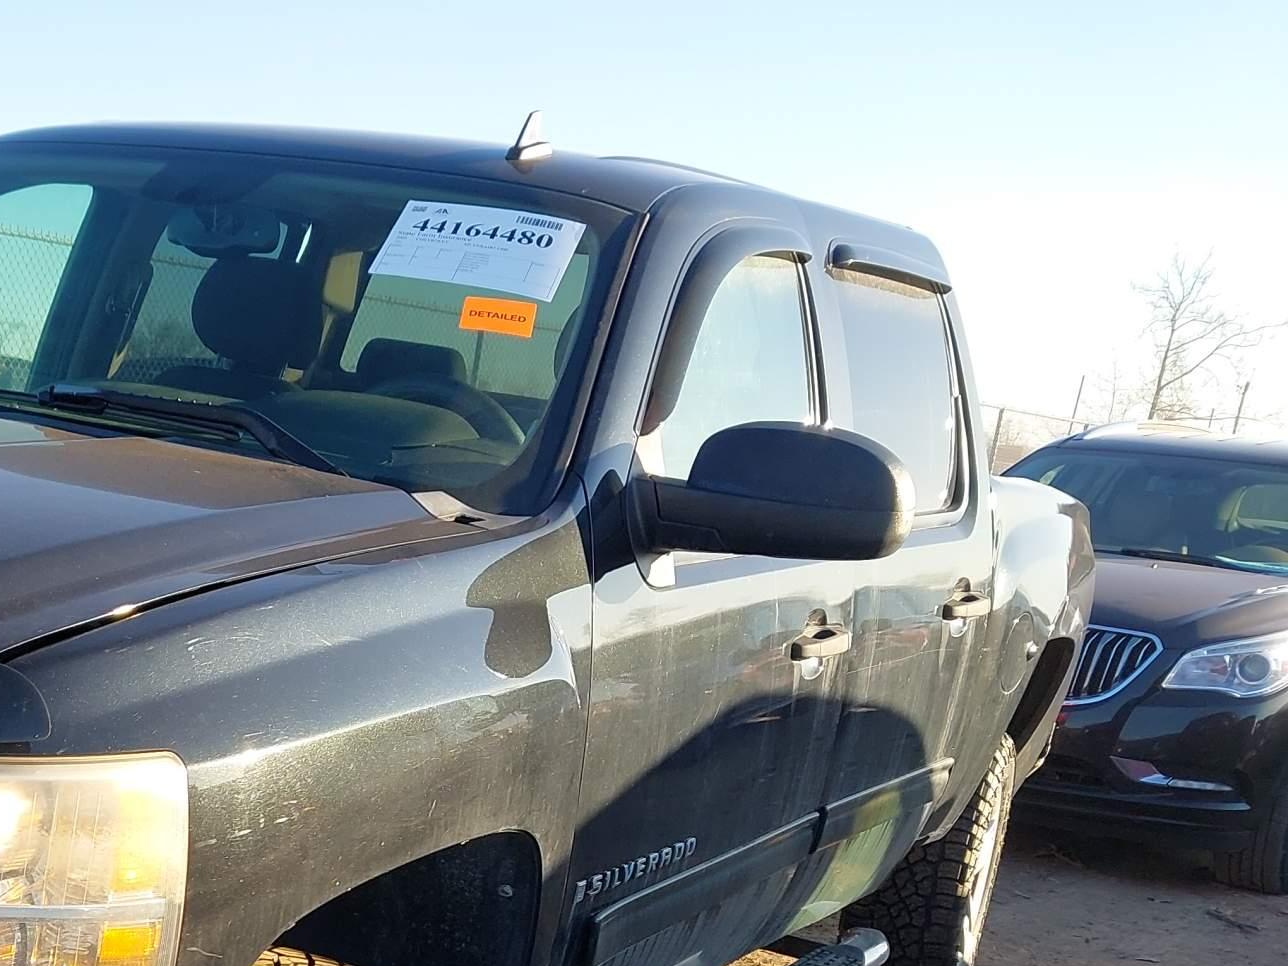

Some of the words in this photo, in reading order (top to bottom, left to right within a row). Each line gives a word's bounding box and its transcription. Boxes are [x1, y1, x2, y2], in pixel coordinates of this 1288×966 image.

[412, 218, 554, 249] 44164480
[468, 308, 527, 323] DETAILED
[586, 836, 697, 896] SILVERADO
